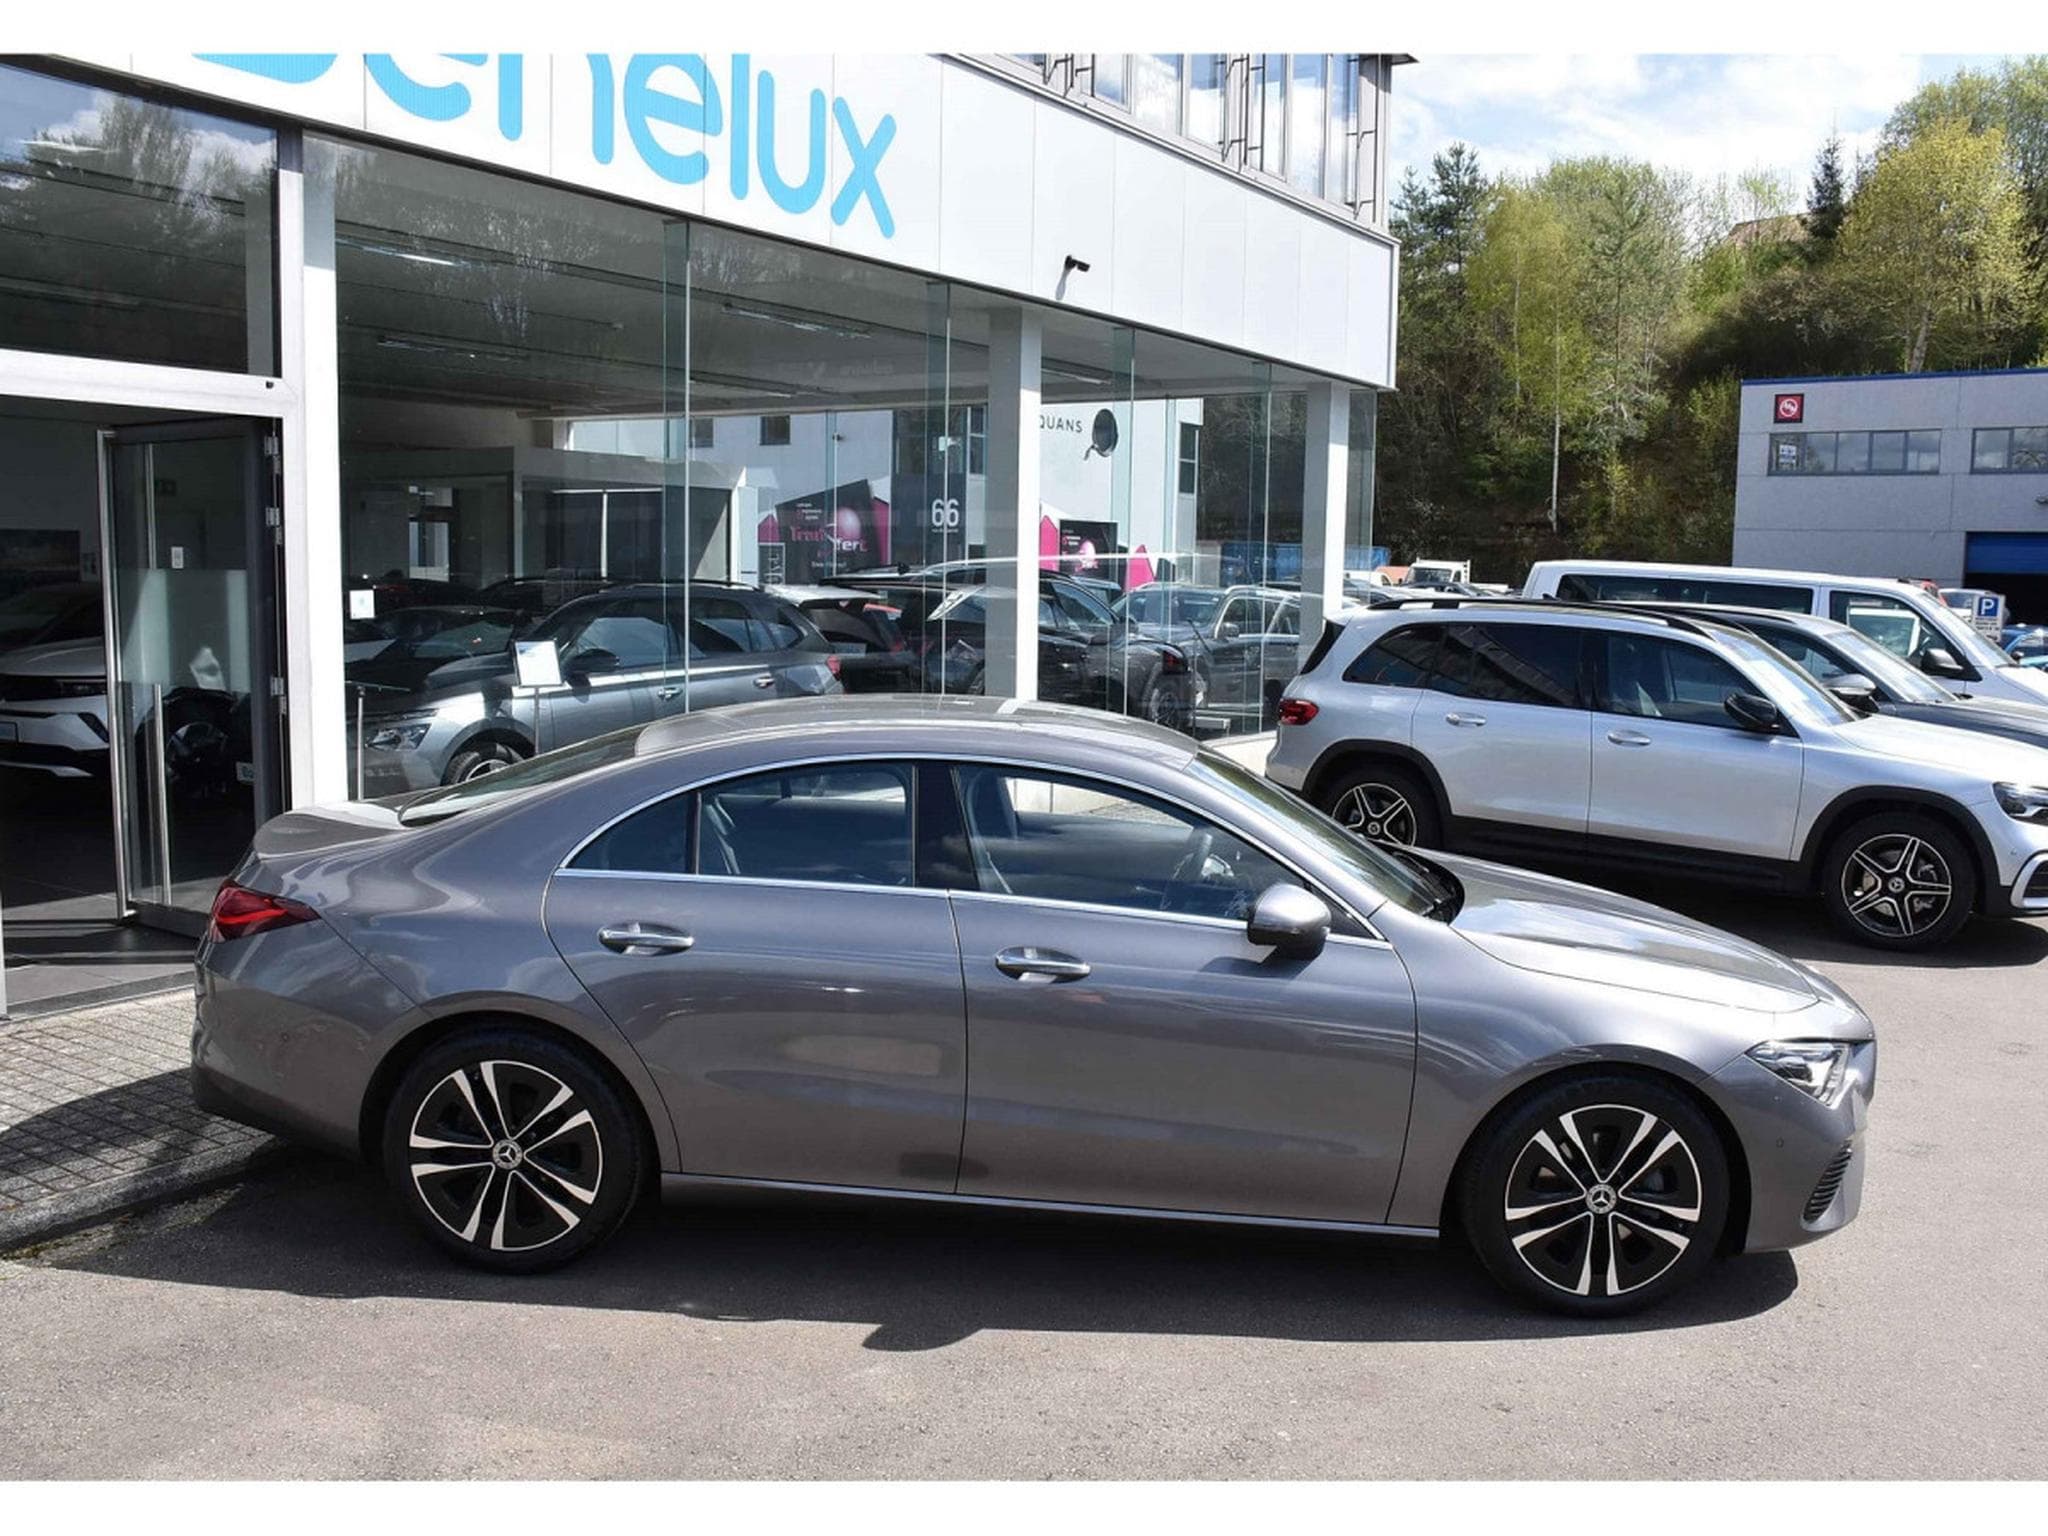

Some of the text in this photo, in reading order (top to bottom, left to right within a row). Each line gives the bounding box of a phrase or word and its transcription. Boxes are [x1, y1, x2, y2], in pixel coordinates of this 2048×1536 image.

[192, 54, 898, 239] nelux
[931, 498, 959, 527] 66
[1980, 598, 1996, 616] P
